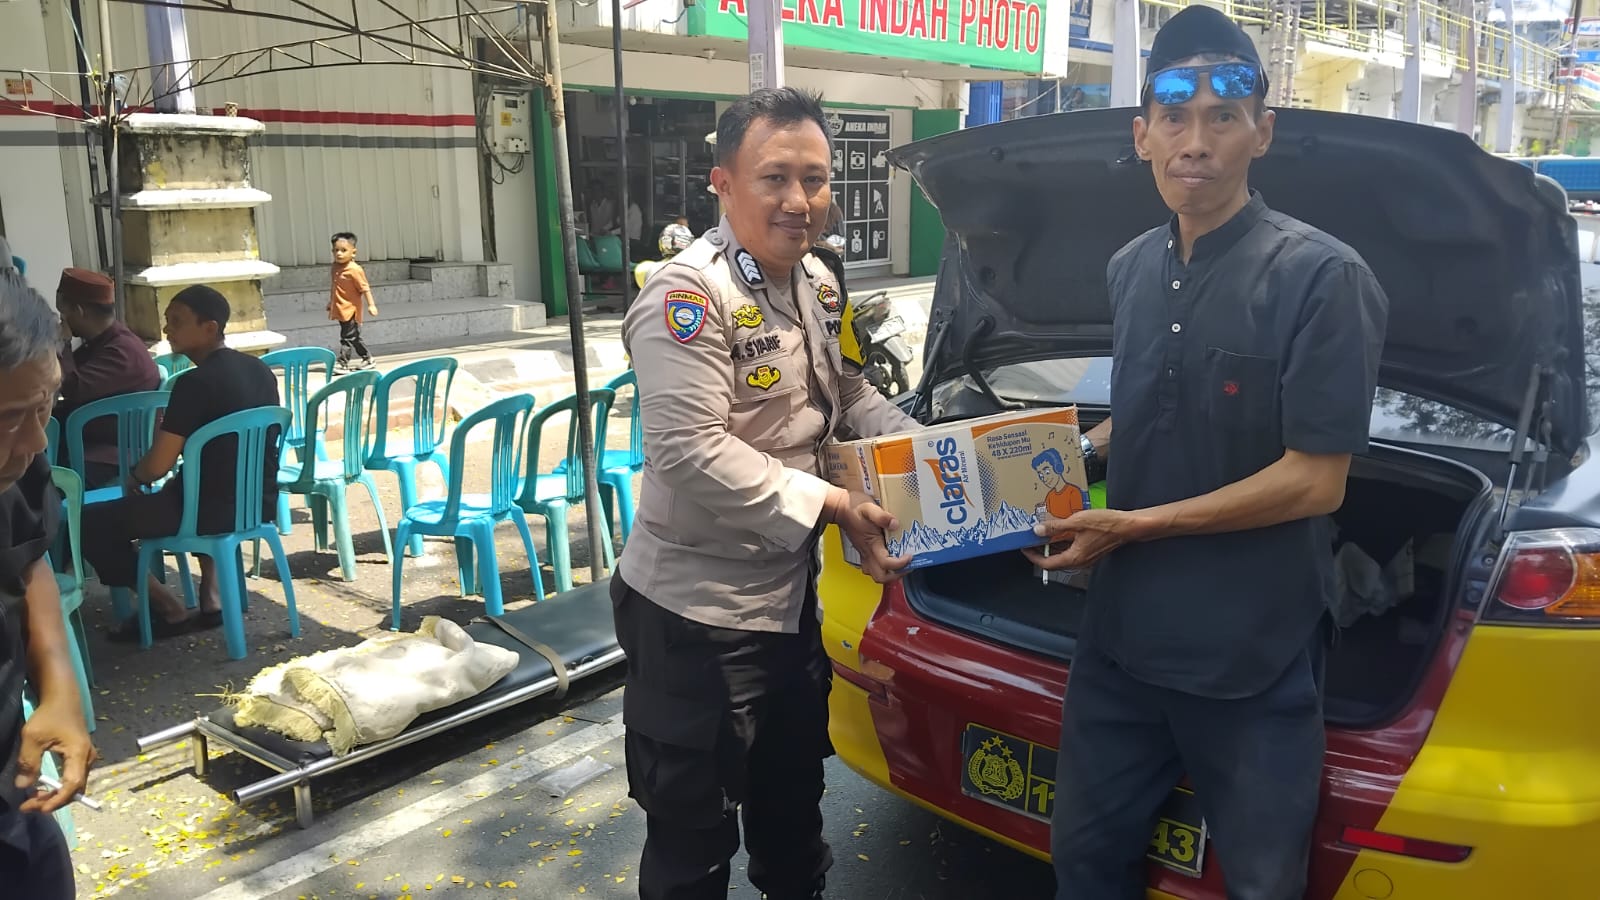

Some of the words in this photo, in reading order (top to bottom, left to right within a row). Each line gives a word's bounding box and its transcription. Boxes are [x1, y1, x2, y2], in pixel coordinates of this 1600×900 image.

[859, 0, 948, 40] INDAH
[959, 0, 1041, 54] PHOTO
[669, 293, 705, 304] BINMAS
[1009, 443, 1032, 454] 220ml
[936, 437, 968, 525] claras
